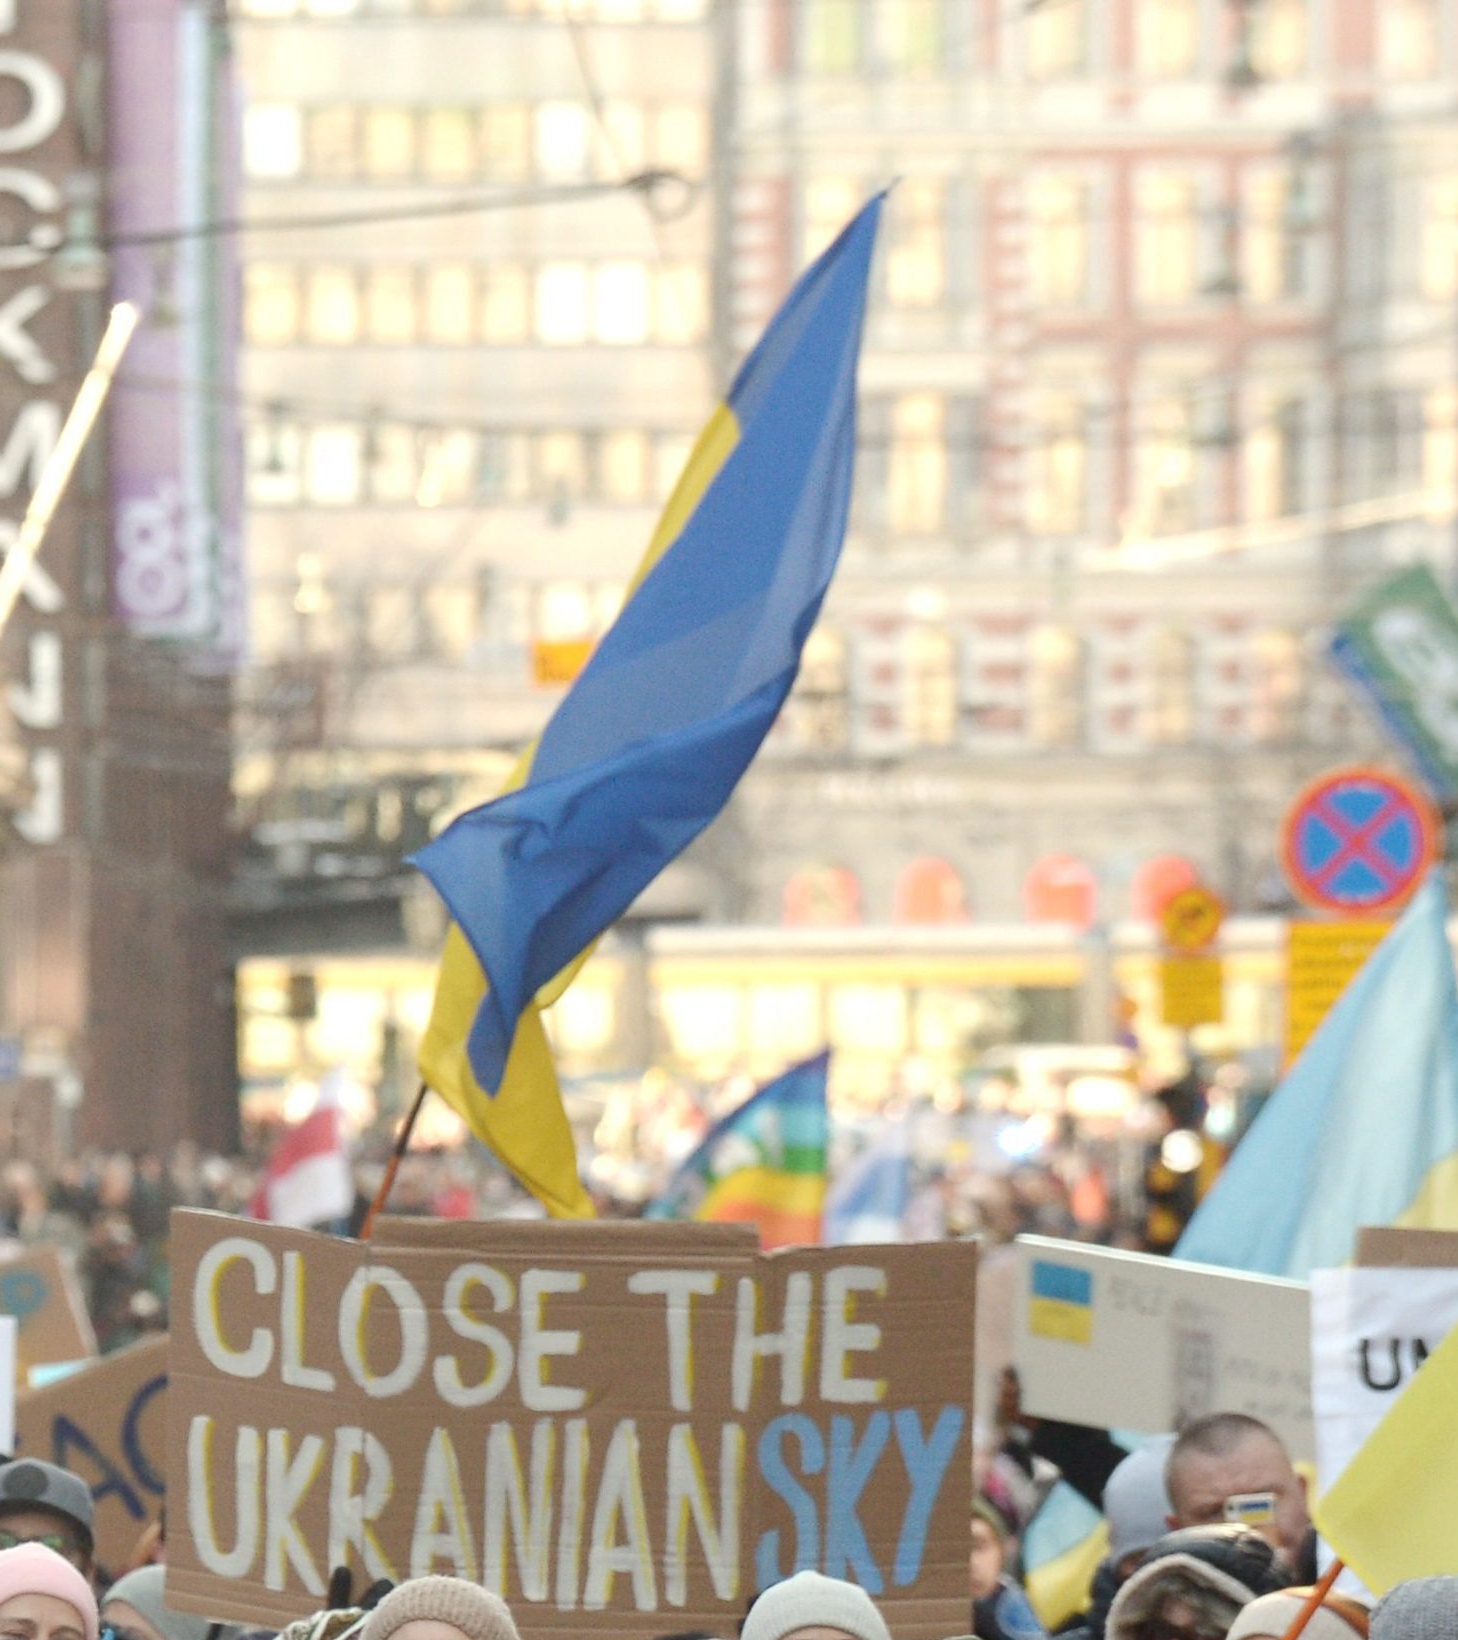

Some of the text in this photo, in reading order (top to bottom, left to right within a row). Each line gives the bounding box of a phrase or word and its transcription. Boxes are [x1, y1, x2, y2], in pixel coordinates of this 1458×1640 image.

[192, 1236, 888, 1411] CLOSE THE
[188, 1404, 966, 1613] UKRANIAN SKY
